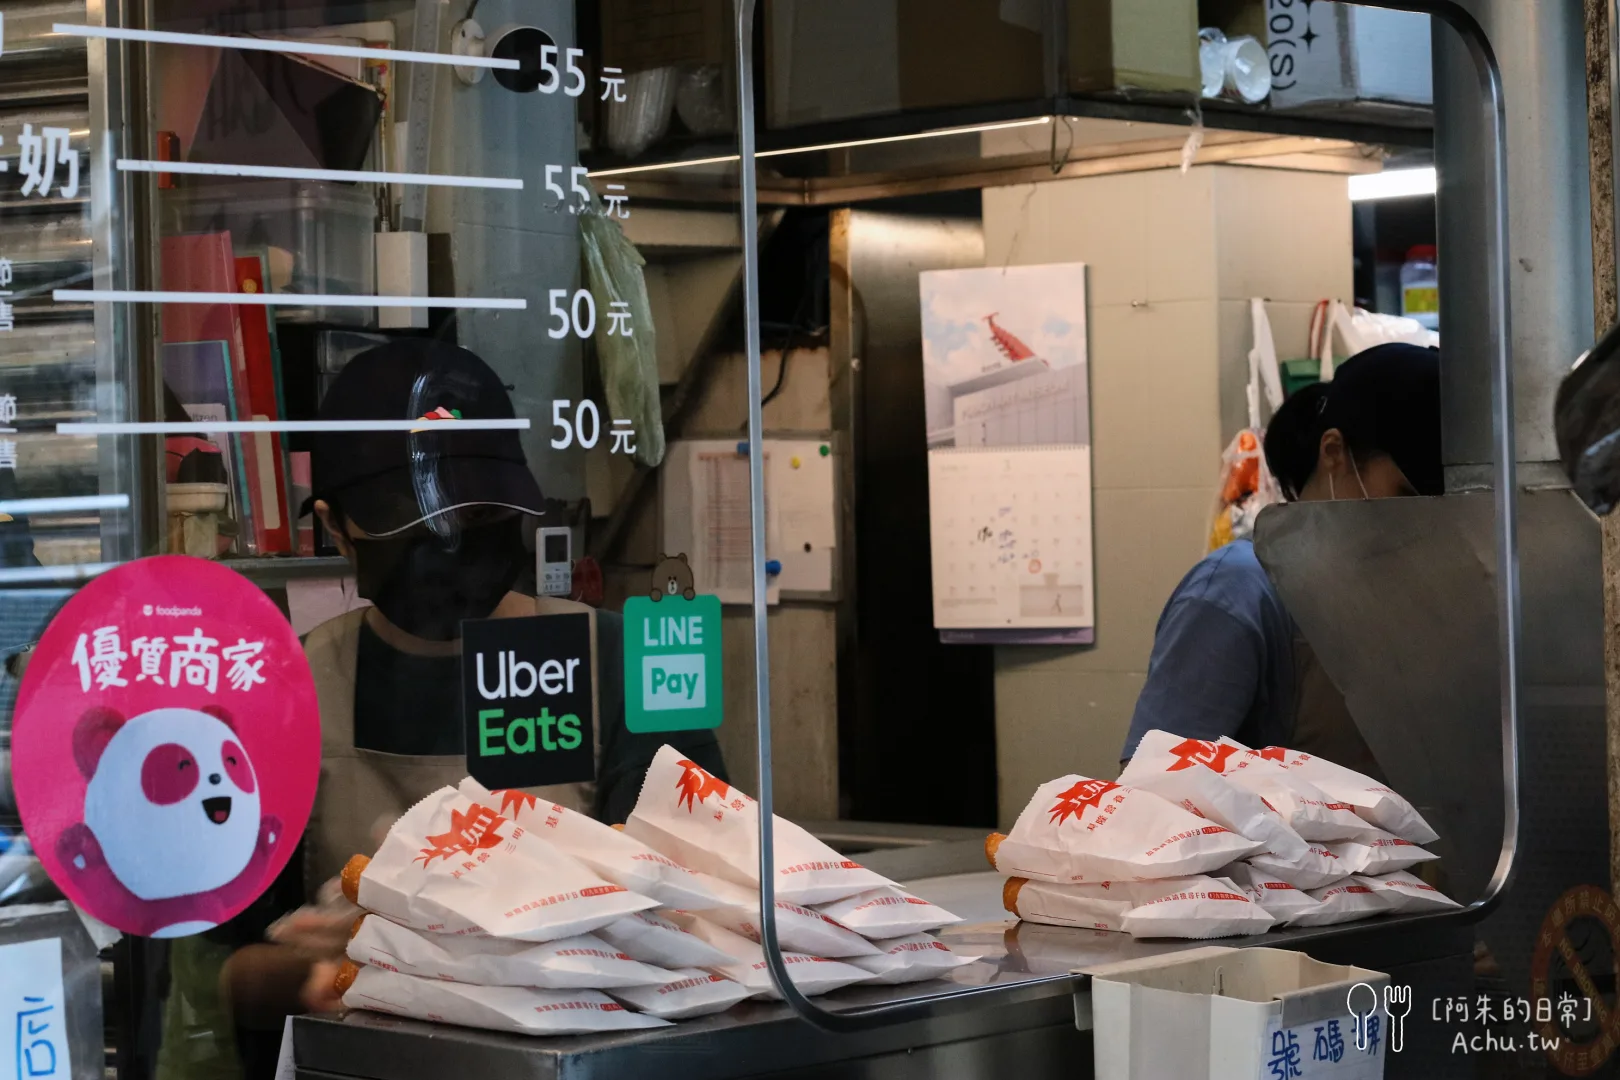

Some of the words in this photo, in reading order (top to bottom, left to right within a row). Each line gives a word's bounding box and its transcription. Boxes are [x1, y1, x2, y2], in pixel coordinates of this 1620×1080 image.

[538, 45, 586, 97] 55
[600, 67, 627, 102] 元
[543, 164, 592, 214] 55
[603, 184, 630, 219] 元
[548, 288, 597, 339] 50
[607, 301, 633, 336] 元
[551, 398, 600, 449] 50
[610, 419, 637, 454] 元
[155, 605, 203, 618] foodpanda
[644, 616, 704, 647] LINE
[71, 625, 266, 694] 優質商家
[476, 650, 580, 700] Uber
[651, 667, 699, 700] Pay
[478, 707, 583, 757] Eats
